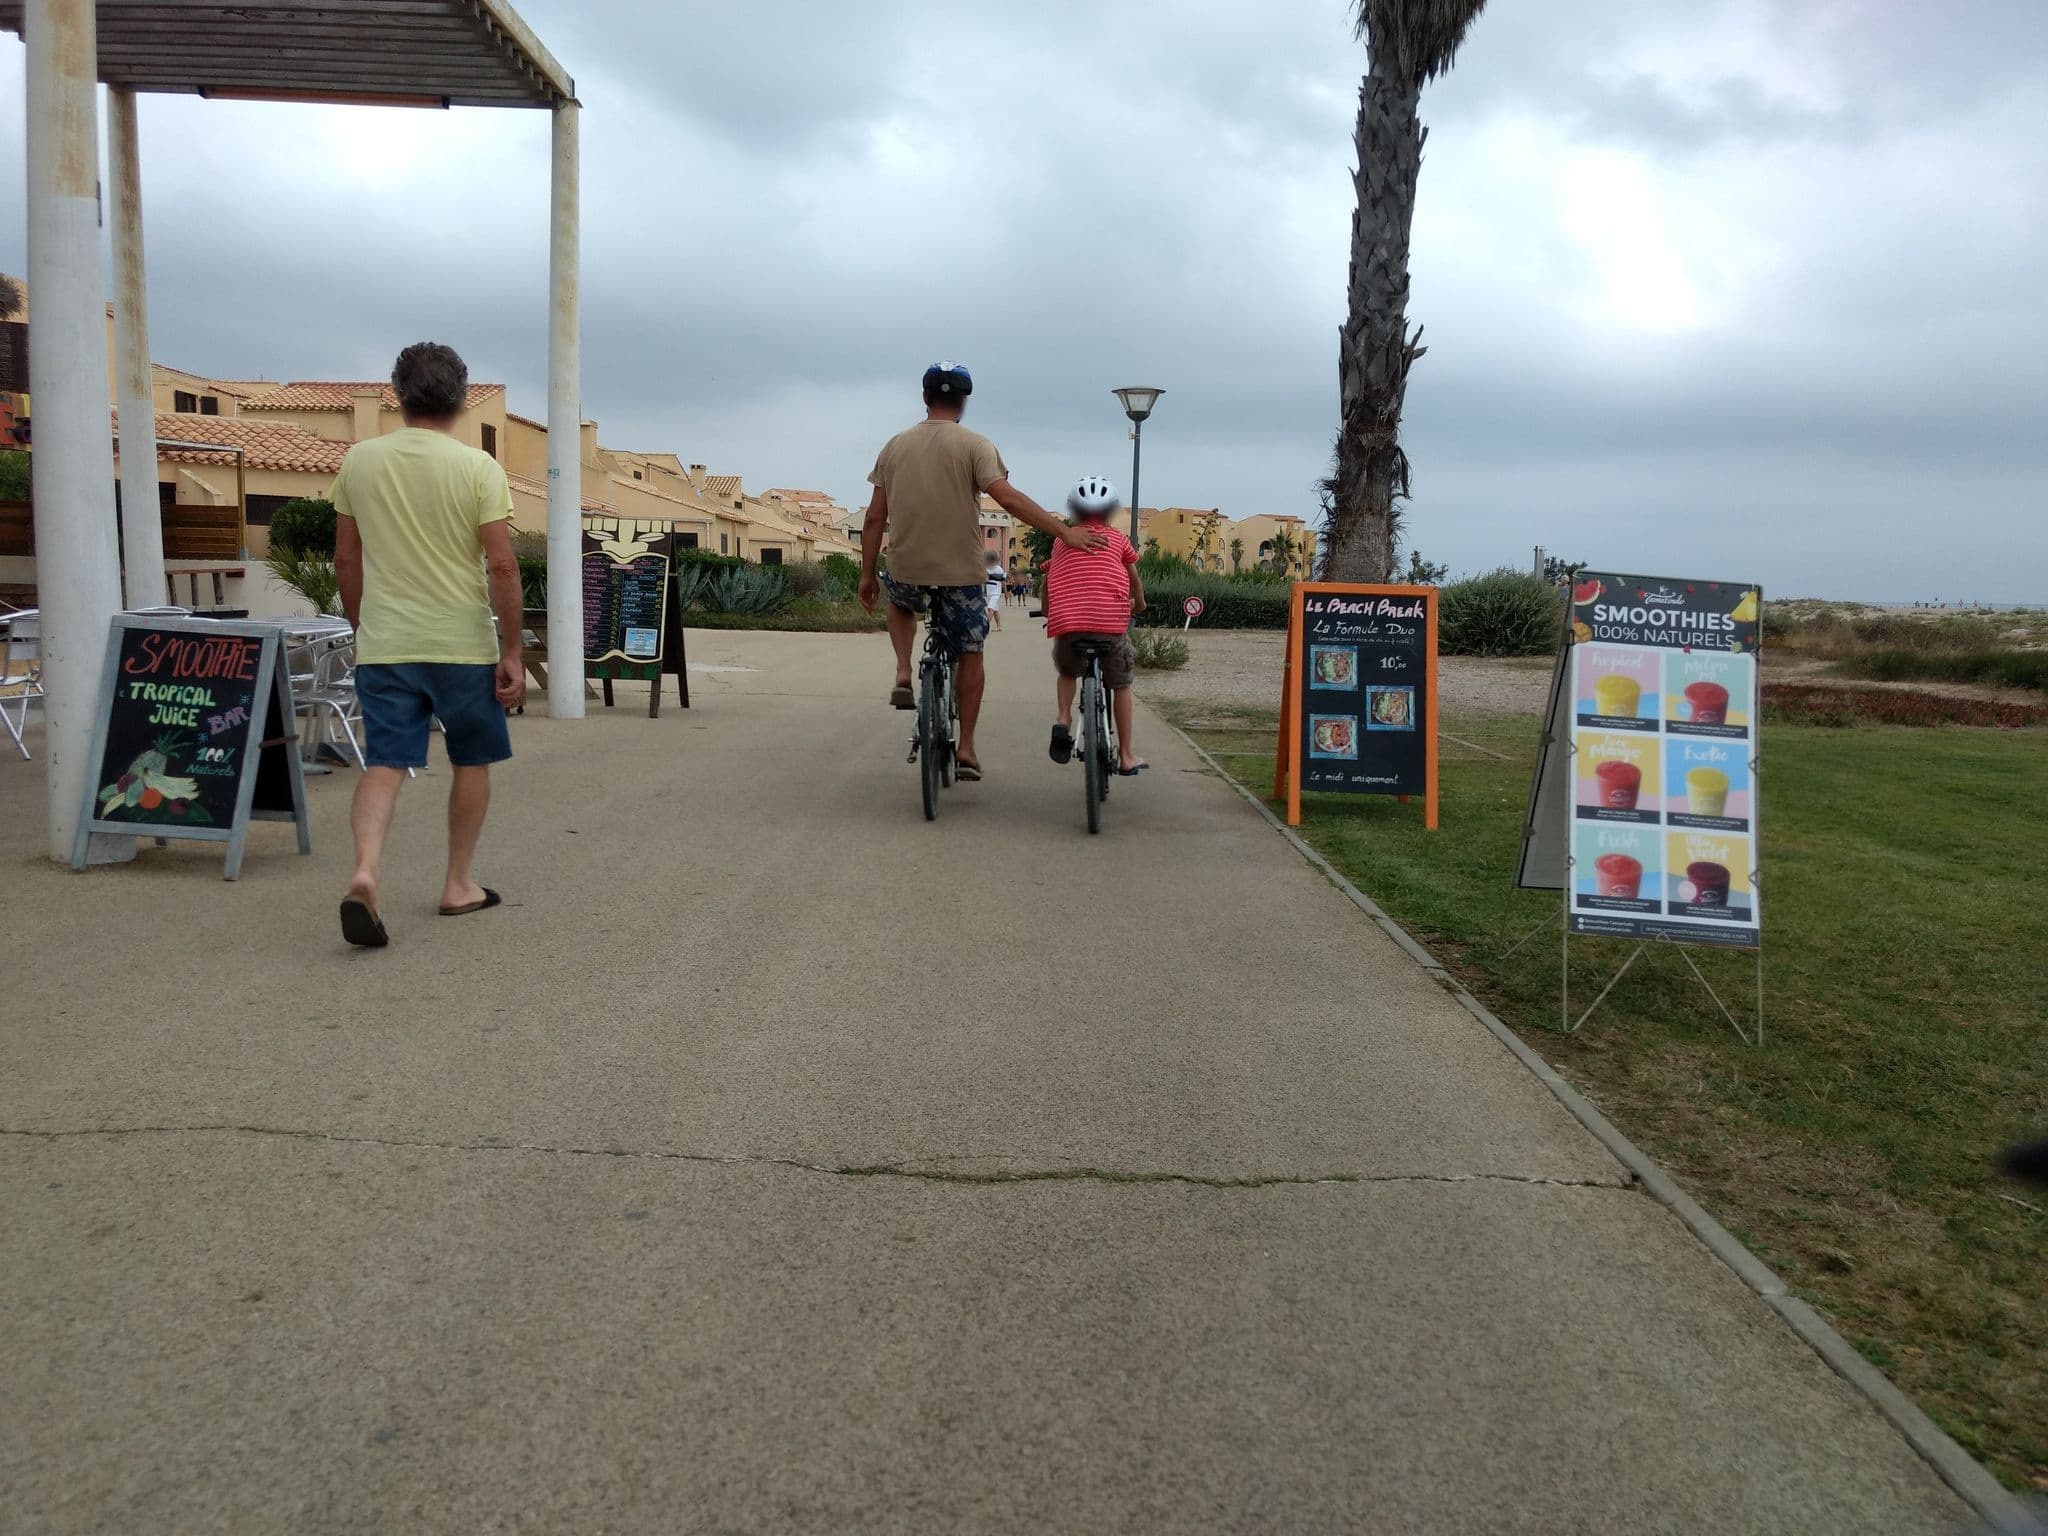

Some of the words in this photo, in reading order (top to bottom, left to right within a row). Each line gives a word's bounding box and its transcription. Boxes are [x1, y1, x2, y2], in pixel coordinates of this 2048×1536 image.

[1305, 599, 1323, 613] LE
[1326, 598, 1375, 616] BEACH
[1593, 604, 1736, 631] SMOOTHIES
[1313, 620, 1331, 634] La
[1334, 620, 1380, 635] Formule
[1385, 623, 1416, 635] Duo
[1592, 624, 1639, 641] 100%
[1644, 628, 1735, 648] NATURELS
[208, 706, 250, 735] BAR
[1325, 772, 1344, 781] midi
